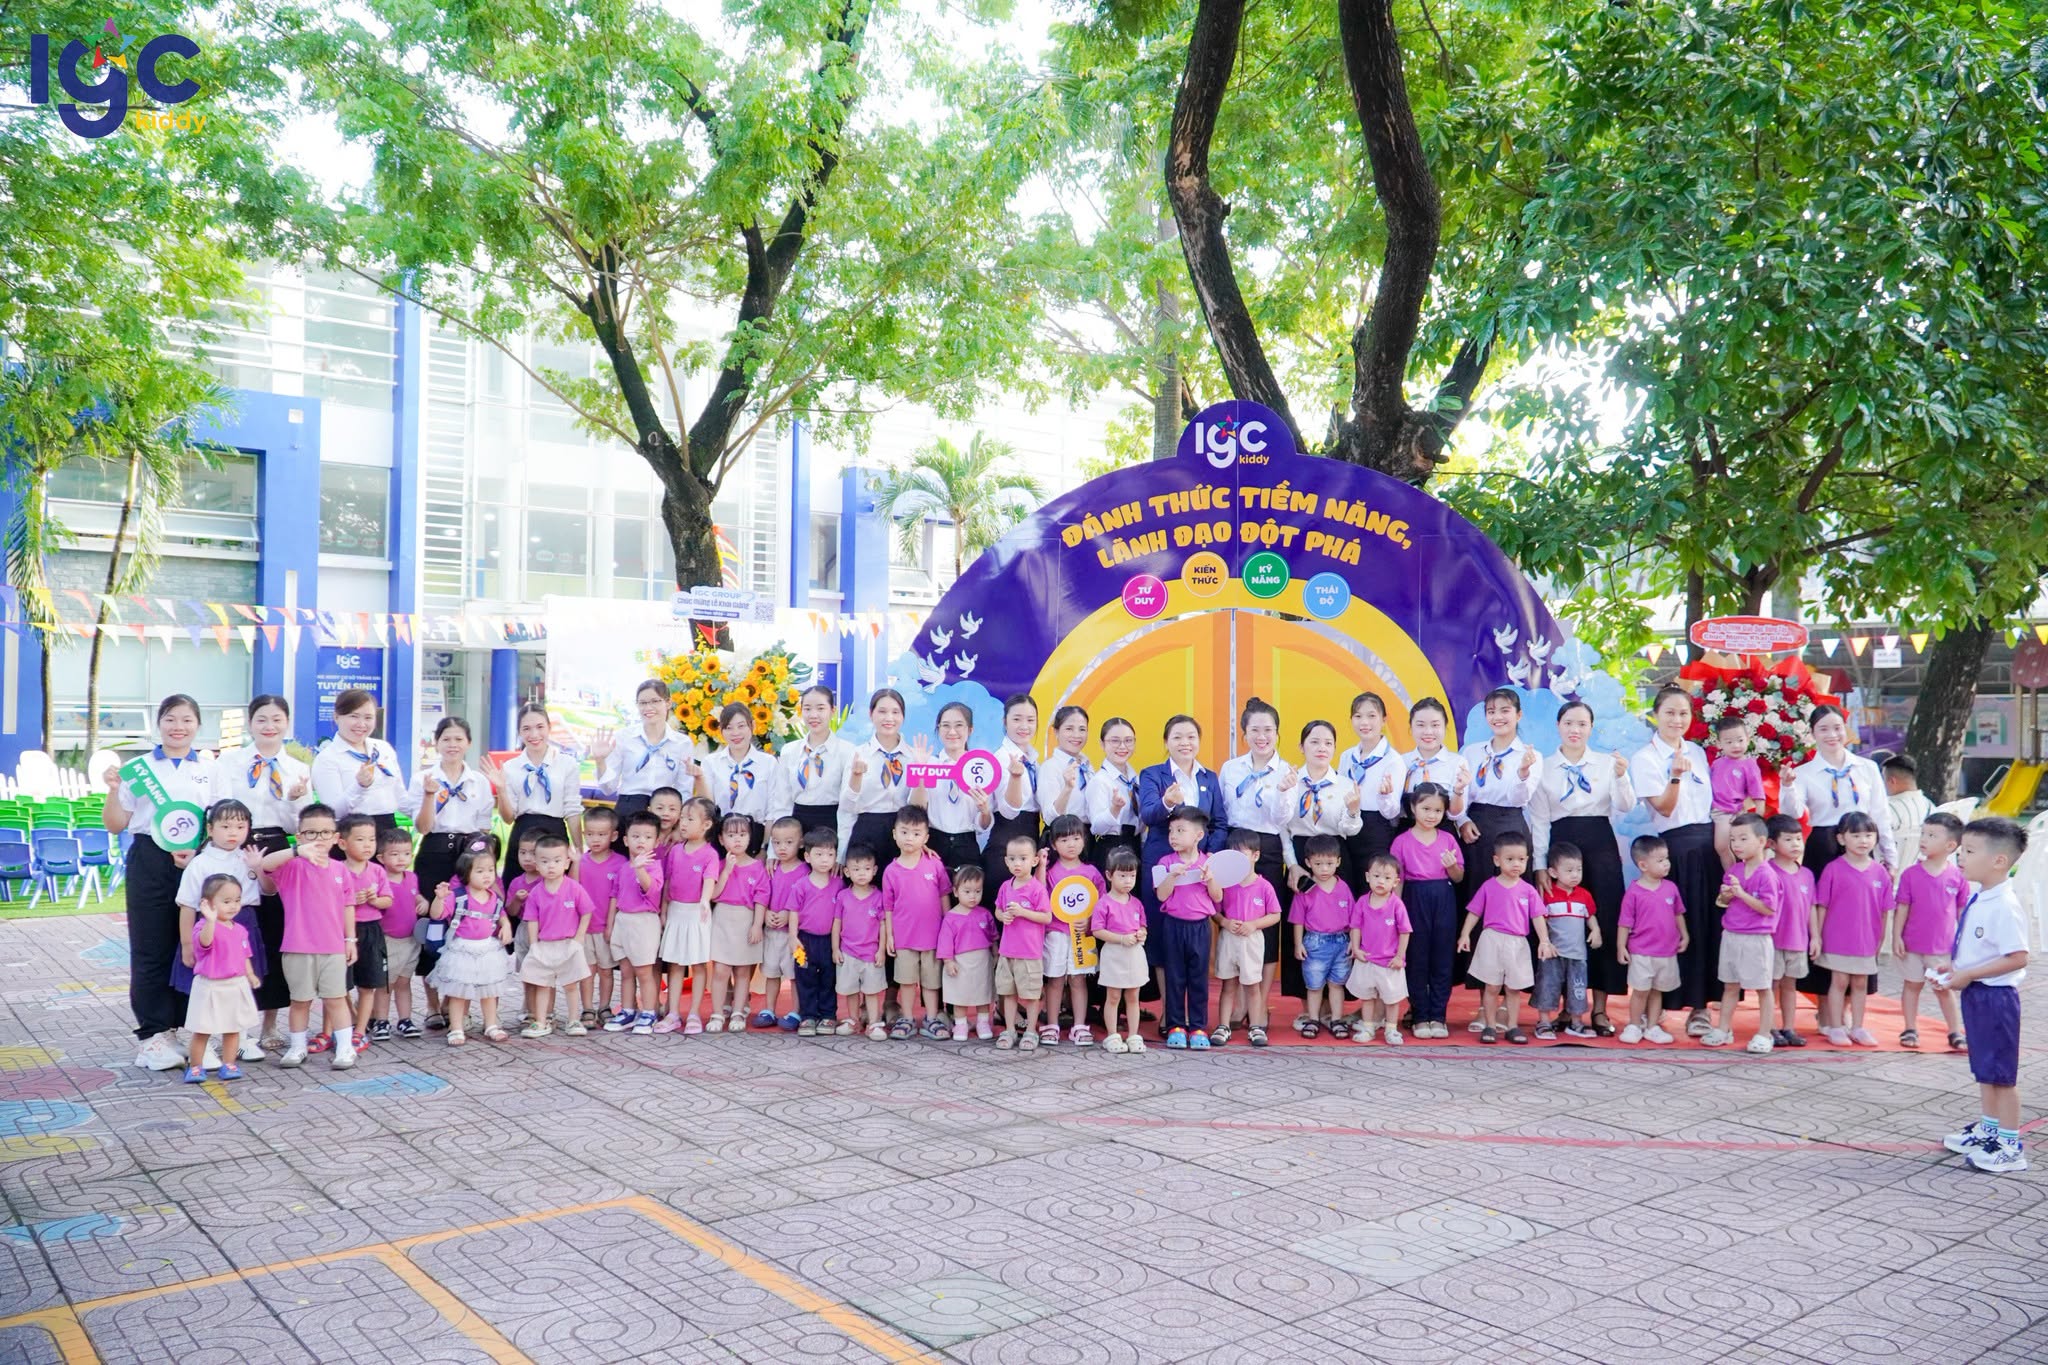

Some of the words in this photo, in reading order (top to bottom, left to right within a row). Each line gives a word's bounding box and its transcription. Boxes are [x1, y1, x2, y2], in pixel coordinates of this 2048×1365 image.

[1239, 454, 1270, 465] kiddy
[1061, 501, 1143, 548] ĐÁNH
[1148, 483, 1231, 517] THỨC
[1239, 480, 1319, 515] TIỀM
[1323, 498, 1412, 550] NĂNG,
[1096, 530, 1168, 569] LÃNH
[1173, 521, 1232, 548] ĐẠO
[1240, 518, 1300, 549] ĐỘT
[1304, 530, 1361, 566] PHÁ
[1193, 563, 1217, 574] KIẾN
[1258, 563, 1273, 574] KỸ
[1191, 575, 1219, 585] THỨC
[1251, 574, 1280, 584] NĂNG
[1138, 586, 1153, 595] TƯ
[1314, 584, 1339, 594] THÁI
[711, 590, 741, 599] GROUP
[1134, 597, 1156, 605] DUY
[1319, 596, 1335, 606] ĐỘ
[910, 766, 927, 777] TƯ
[927, 768, 951, 777] DUY
[132, 763, 149, 777] KỸ
[143, 777, 167, 805] NĂNG
